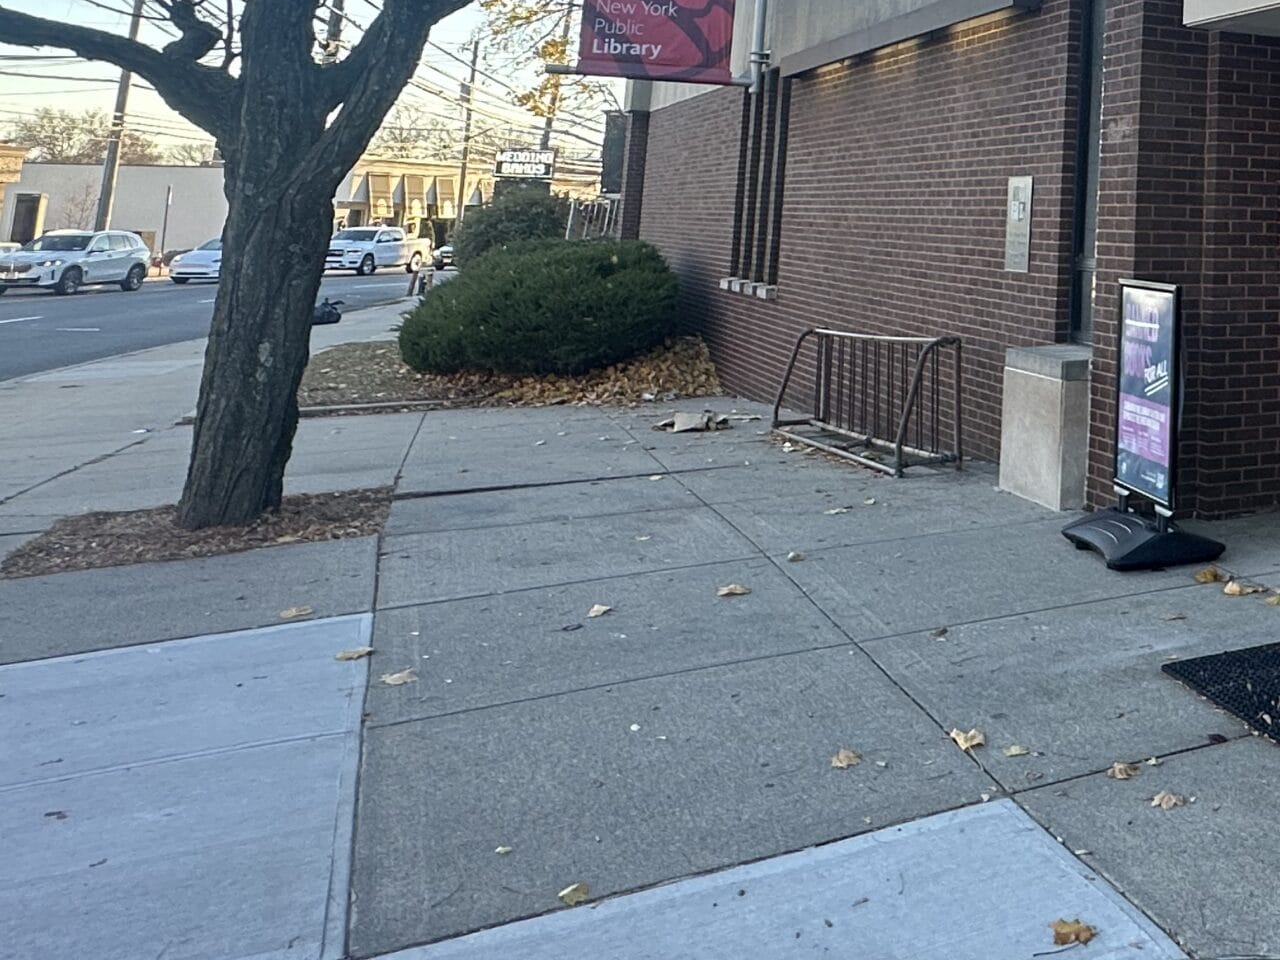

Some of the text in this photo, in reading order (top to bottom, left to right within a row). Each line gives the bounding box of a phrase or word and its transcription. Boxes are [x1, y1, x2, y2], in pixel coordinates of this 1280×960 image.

[641, 0, 678, 17] York
[594, 18, 645, 35] Public
[592, 38, 662, 60] Library
